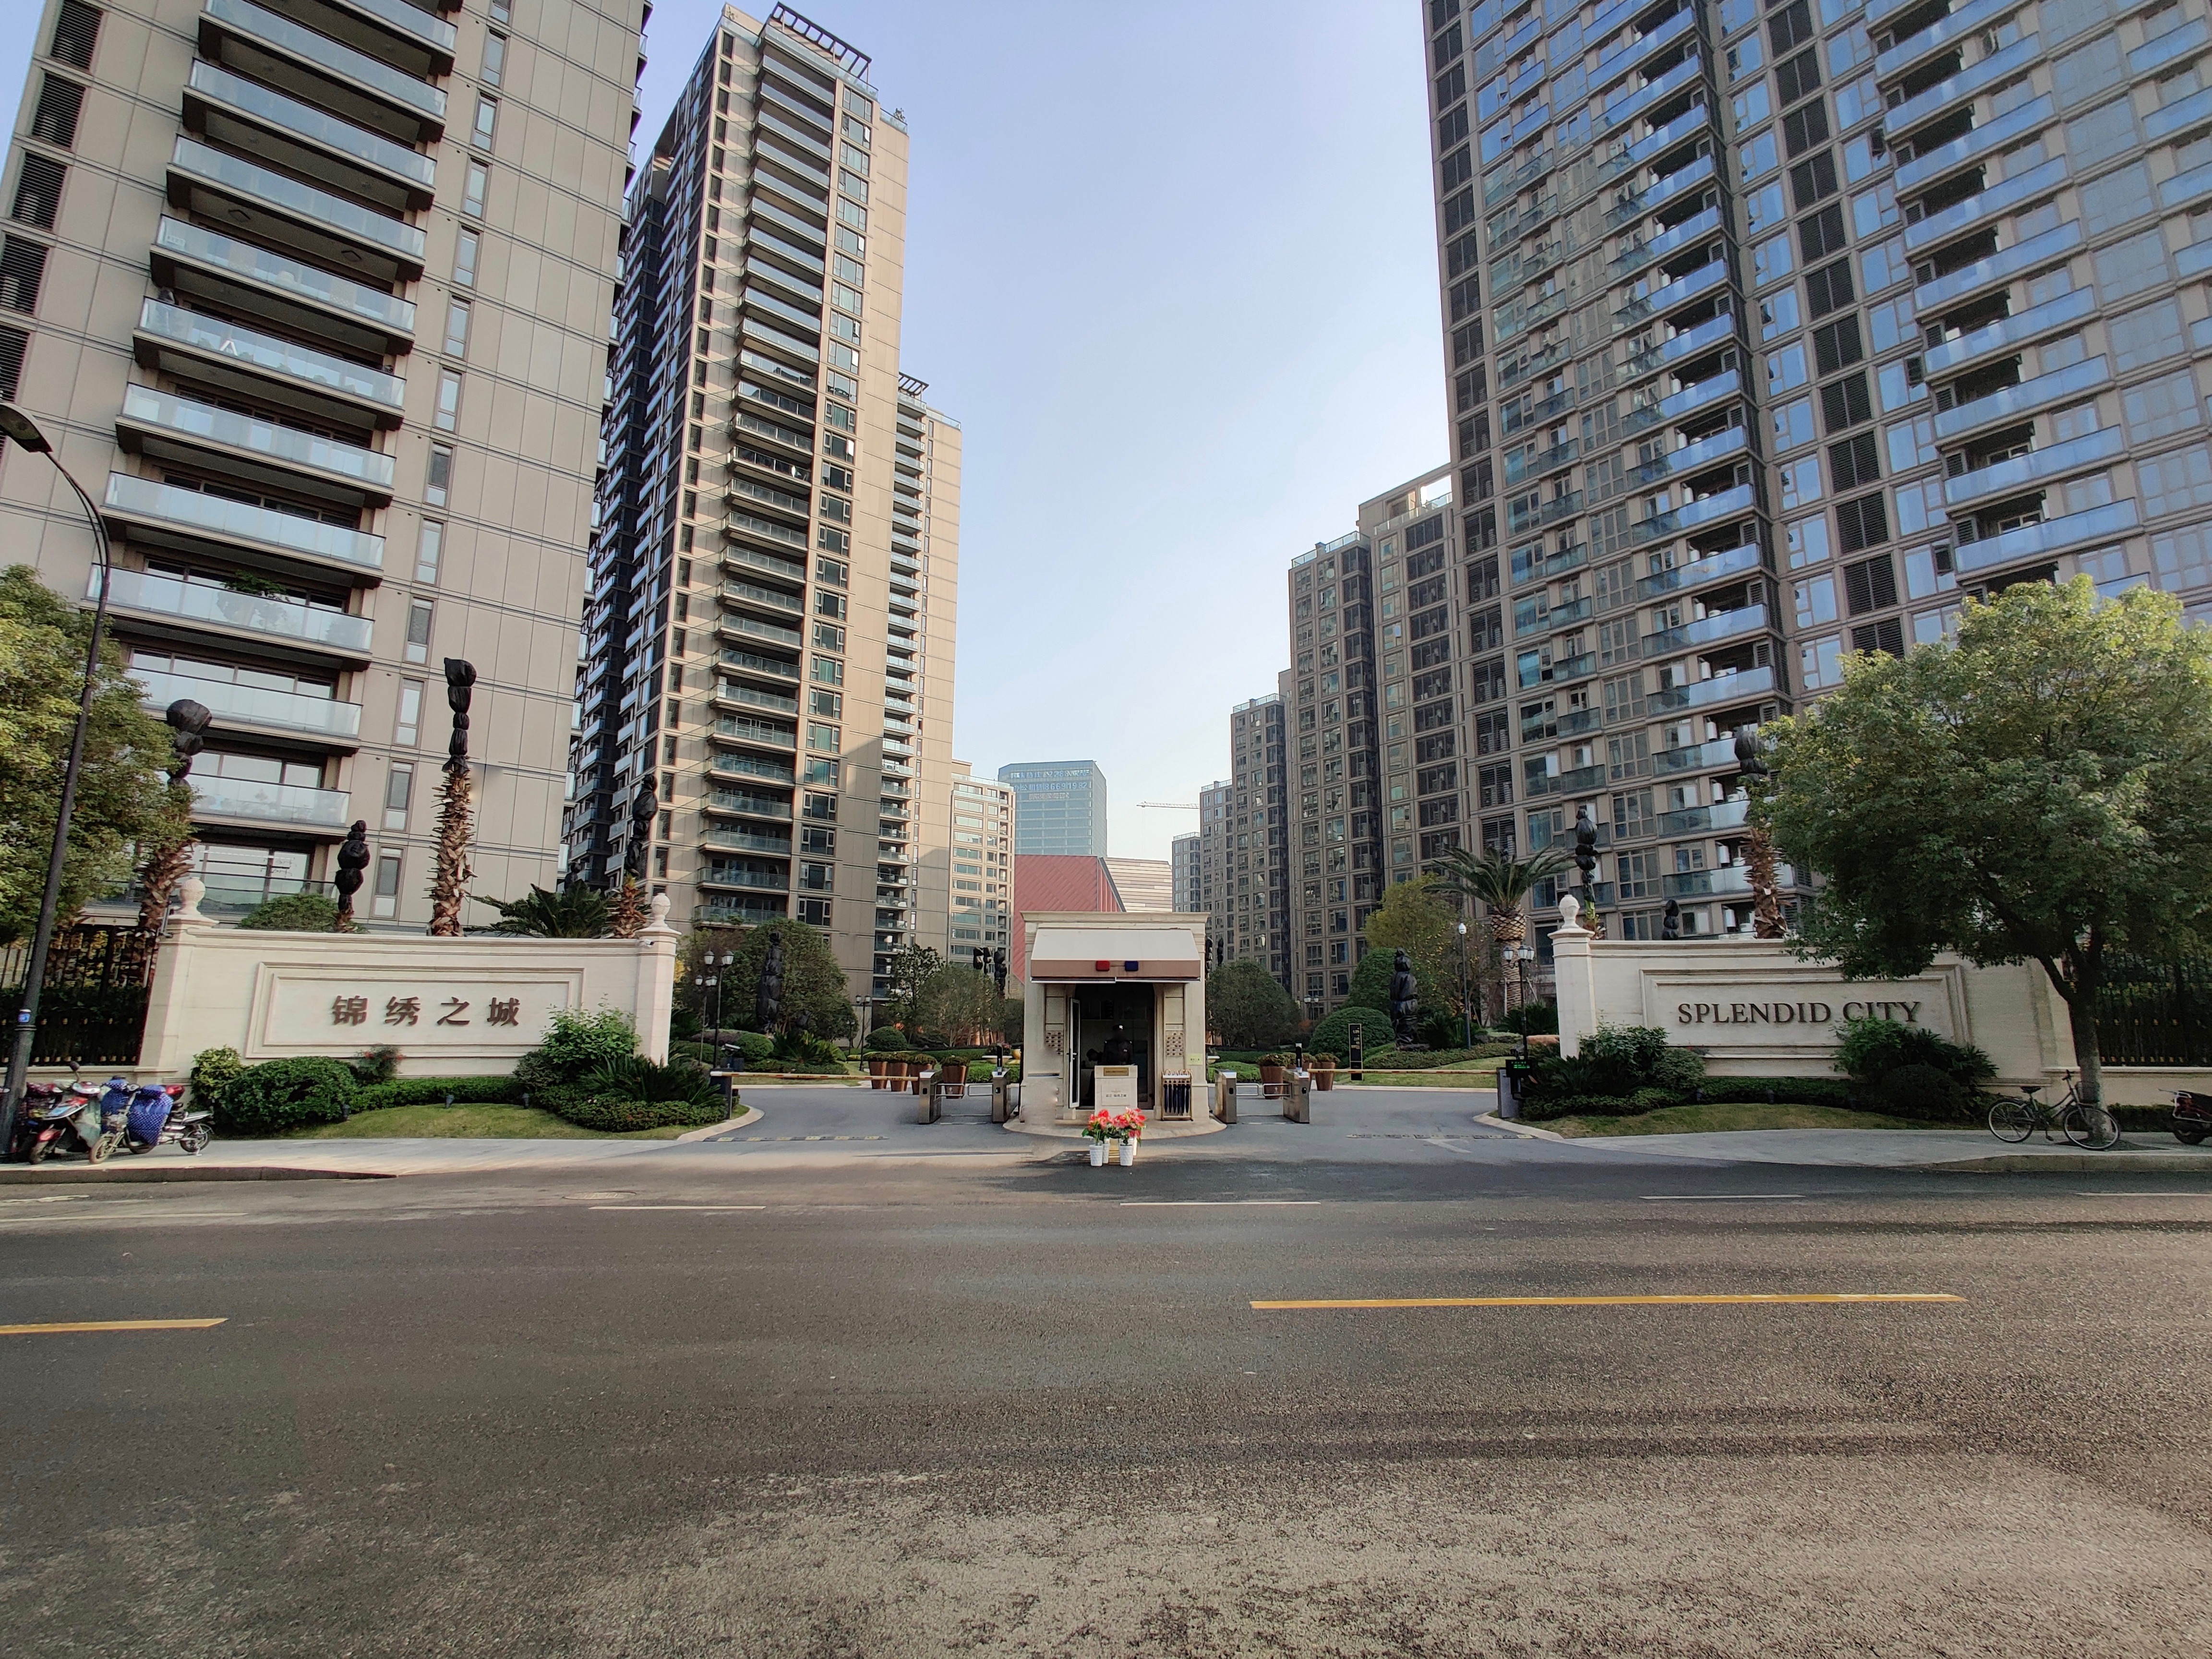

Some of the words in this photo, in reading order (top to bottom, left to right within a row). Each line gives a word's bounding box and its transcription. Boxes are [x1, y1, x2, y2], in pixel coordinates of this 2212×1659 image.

[332, 995, 520, 1026] 锦绣之城
[1678, 1002, 1831, 1023] SPLENDID
[1843, 1001, 1920, 1022] CITY
